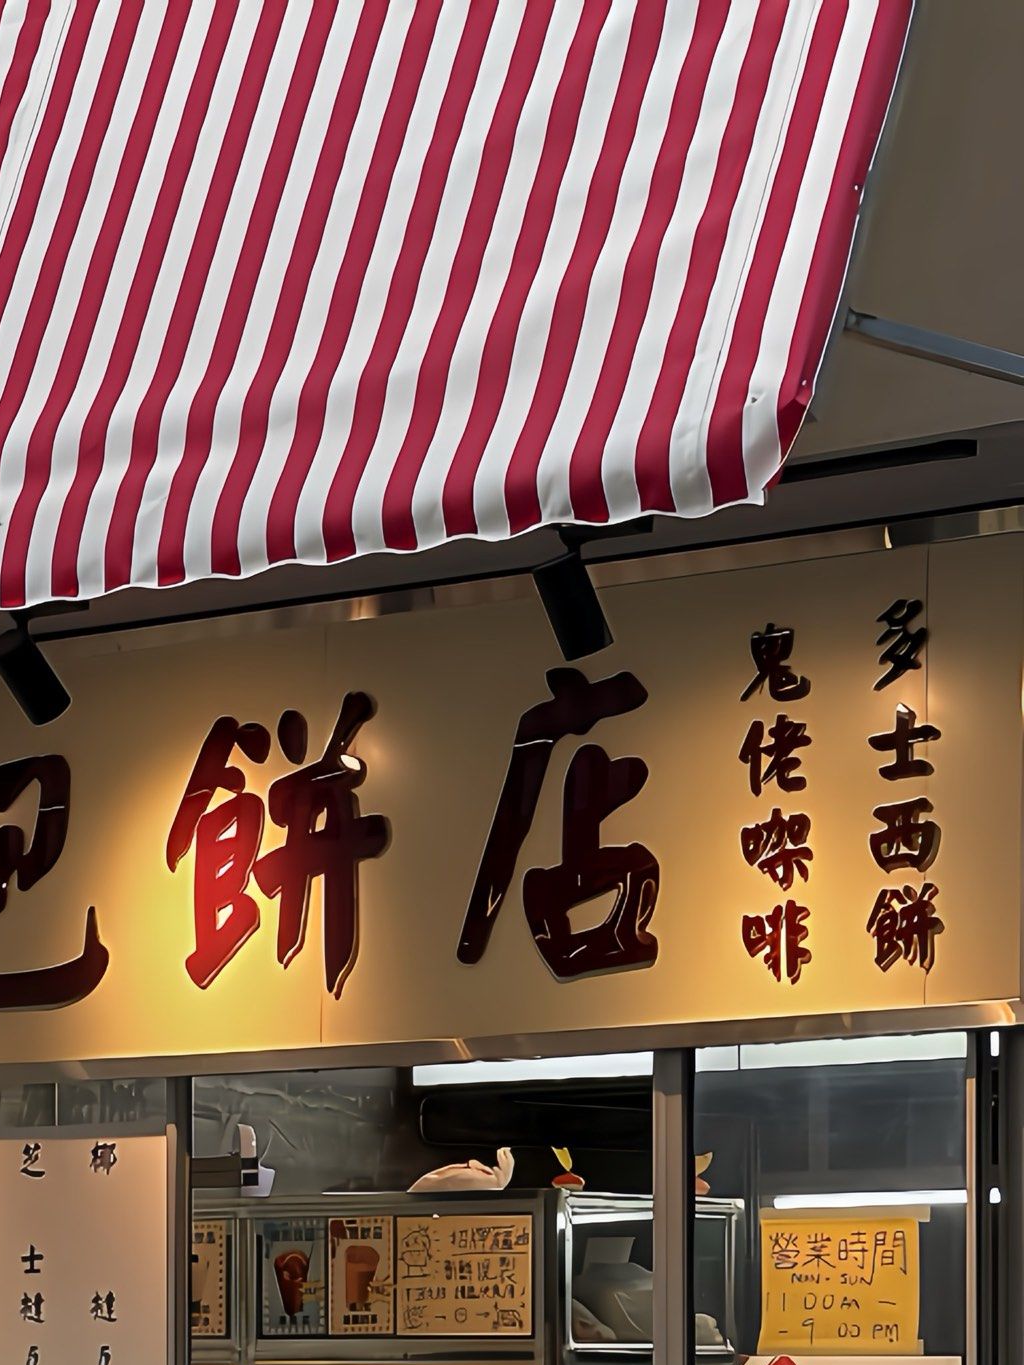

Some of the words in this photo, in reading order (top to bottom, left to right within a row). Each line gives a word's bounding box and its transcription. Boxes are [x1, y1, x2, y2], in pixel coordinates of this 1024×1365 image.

[866, 598, 945, 975] 多士西餅
[769, 1230, 908, 1276] 營業時間
